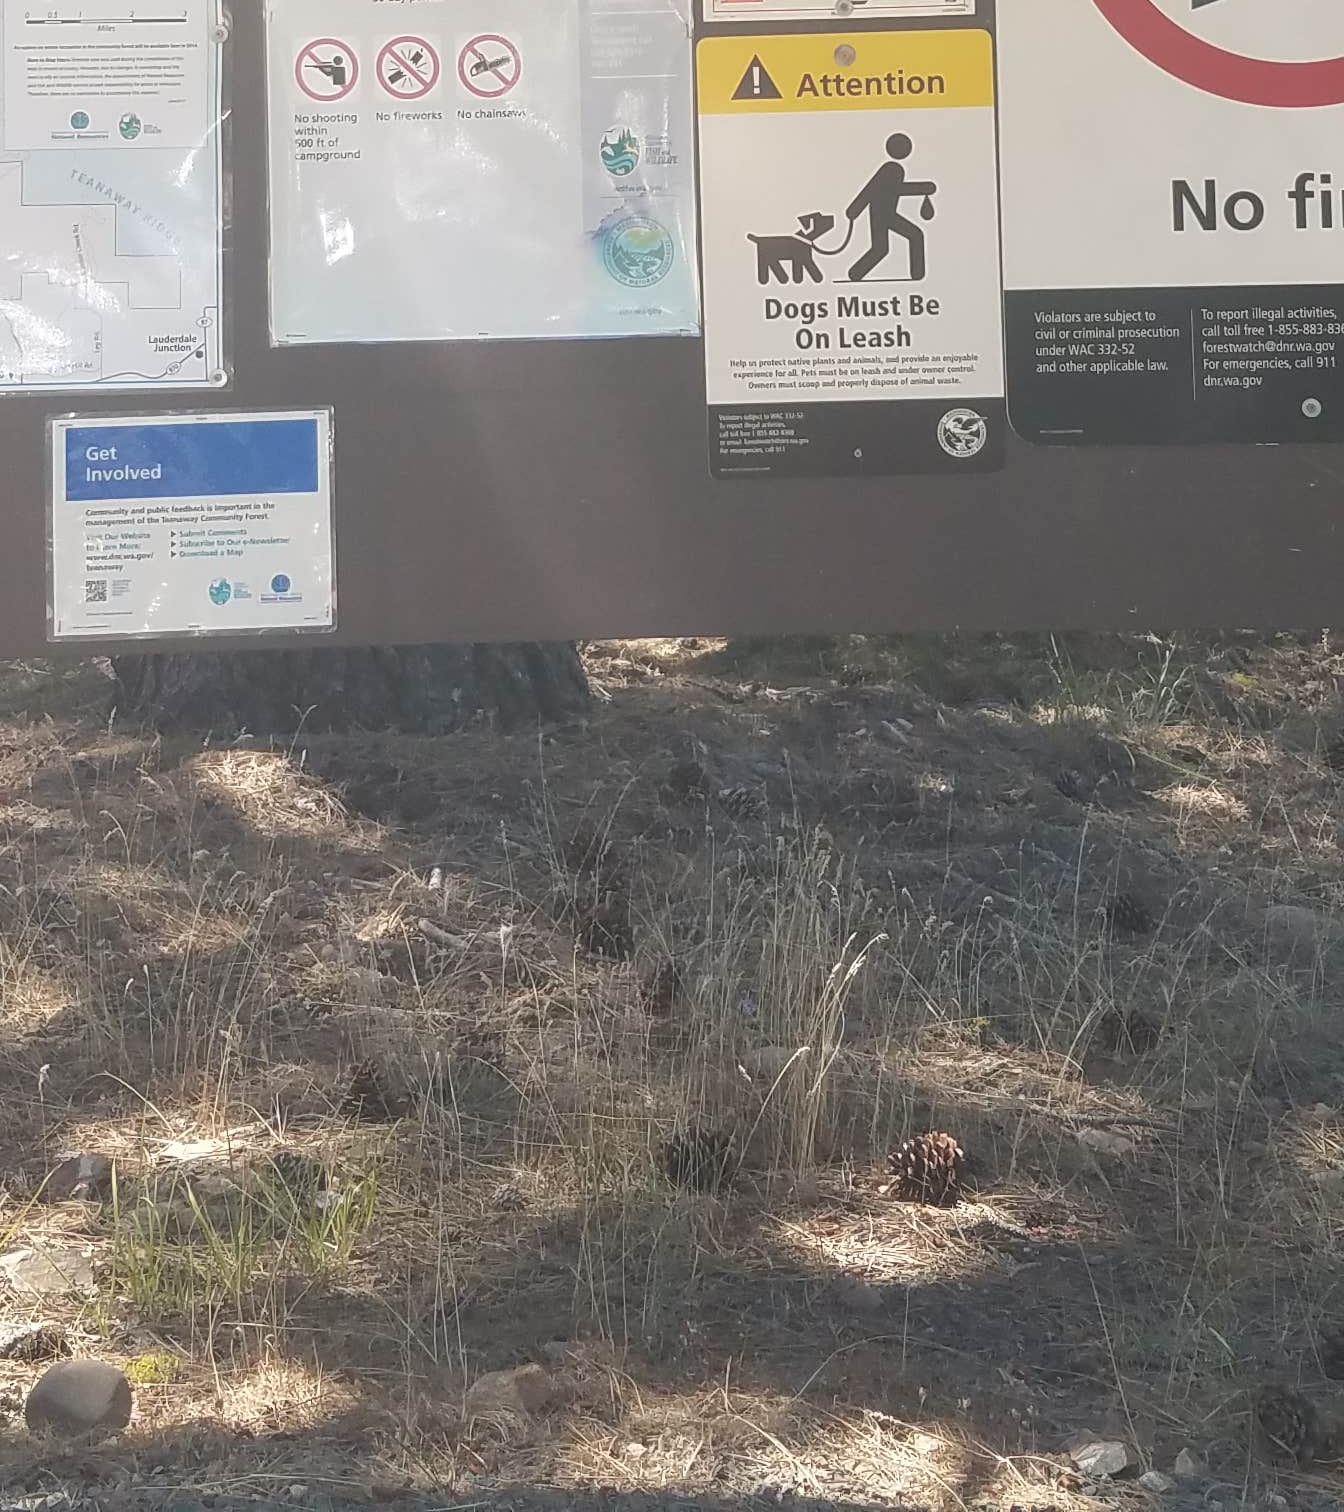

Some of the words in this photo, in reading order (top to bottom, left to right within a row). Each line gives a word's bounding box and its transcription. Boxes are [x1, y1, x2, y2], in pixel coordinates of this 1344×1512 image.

[797, 70, 945, 98] Attention
[295, 114, 308, 122] No
[312, 113, 357, 123] shooting
[376, 112, 389, 120] No
[394, 111, 442, 120] fireworks
[457, 110, 471, 119] No
[295, 126, 327, 135] within
[317, 138, 324, 147] ft
[328, 138, 338, 147] of
[295, 150, 361, 161] campground
[1172, 179, 1264, 232] No
[766, 298, 828, 324] Dogs
[838, 296, 901, 319] Must
[910, 294, 940, 316] Be
[1201, 309, 1213, 320] To
[1217, 310, 1249, 322] report
[1252, 307, 1283, 321] illegal
[1288, 307, 1337, 319] activities,
[1035, 311, 1081, 323] Violators
[1084, 313, 1100, 321] are
[1104, 309, 1141, 324] subject
[1145, 311, 1155, 321] to
[1035, 327, 1055, 339] civil
[1059, 330, 1070, 339] or
[1073, 326, 1114, 339] criminal
[1118, 325, 1179, 340] prosecution
[1202, 325, 1220, 336] call
[1224, 325, 1240, 336] toll
[1244, 324, 1264, 335] free
[149, 334, 197, 343] Lauderdale
[796, 328, 829, 350] On
[838, 325, 911, 349] Leash
[154, 344, 191, 352] Junction
[1036, 345, 1066, 356] under
[1068, 344, 1094, 355] WAC
[1098, 343, 1135, 355] 332-52
[1203, 340, 1335, 353] forestwatch@dnr.wa.gov
[1036, 361, 1055, 373] and
[1059, 360, 1087, 372] other
[1090, 359, 1144, 374] applicable
[1148, 358, 1168, 370] law.
[1204, 359, 1219, 369] For
[1223, 357, 1291, 371] emergencies,
[1295, 356, 1313, 368] call
[1317, 357, 1336, 367] 911
[1204, 375, 1262, 388] dnr.wa.gov
[86, 446, 117, 460] Get
[86, 465, 161, 482] Involved
